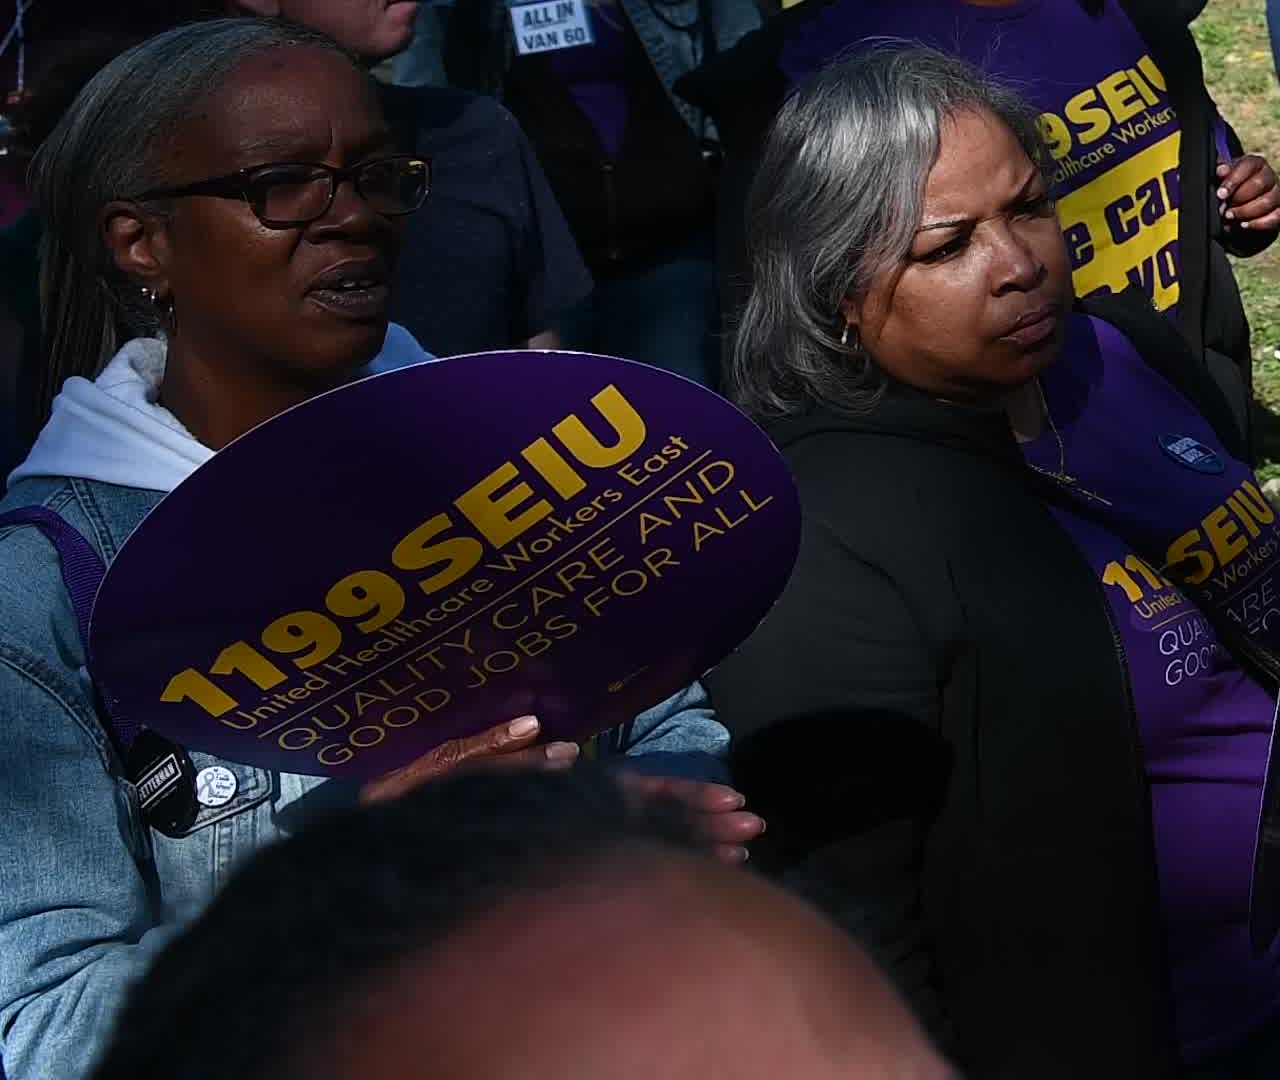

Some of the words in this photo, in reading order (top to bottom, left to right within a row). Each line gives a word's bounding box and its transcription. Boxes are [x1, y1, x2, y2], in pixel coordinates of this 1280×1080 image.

[523, 5, 553, 27] ALL
[556, 2, 575, 18] IN
[523, 31, 559, 50] VAN
[564, 28, 585, 42] 60
[161, 383, 648, 718] 1199SEIU
[220, 670, 330, 733] United
[333, 576, 495, 677] Healthcare
[491, 487, 623, 575] Workers
[616, 434, 691, 484] East
[278, 631, 478, 753] QUALITY
[487, 537, 625, 633] CARE
[639, 457, 737, 544] AND
[317, 686, 452, 768] GOOD
[466, 614, 579, 689] JOBS
[584, 546, 681, 617] FOR
[691, 492, 774, 552] ALL
